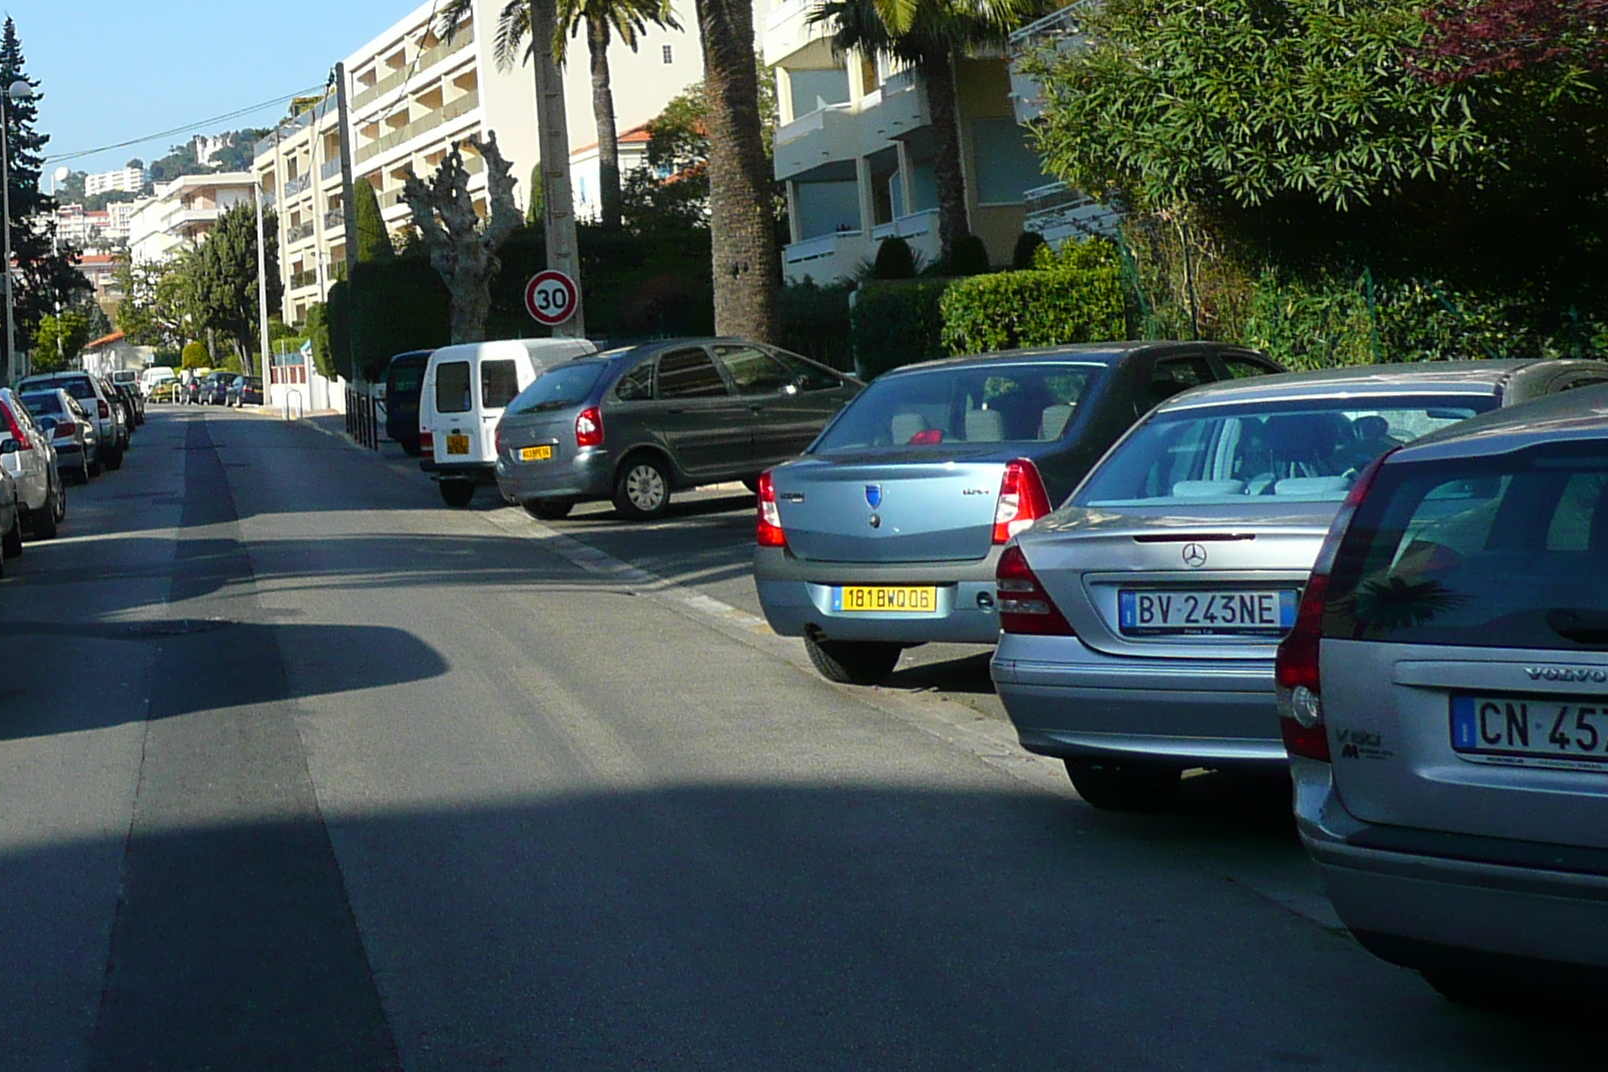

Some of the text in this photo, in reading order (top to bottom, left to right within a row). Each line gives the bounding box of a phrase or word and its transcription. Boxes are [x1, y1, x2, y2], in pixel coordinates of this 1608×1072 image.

[537, 289, 567, 310] 30
[849, 589, 930, 608] 181 BWQ 06
[1139, 595, 1172, 624] BV
[1183, 594, 1276, 624] 243NE
[1524, 667, 1607, 683] VOLVO
[1480, 701, 1530, 747] CN
